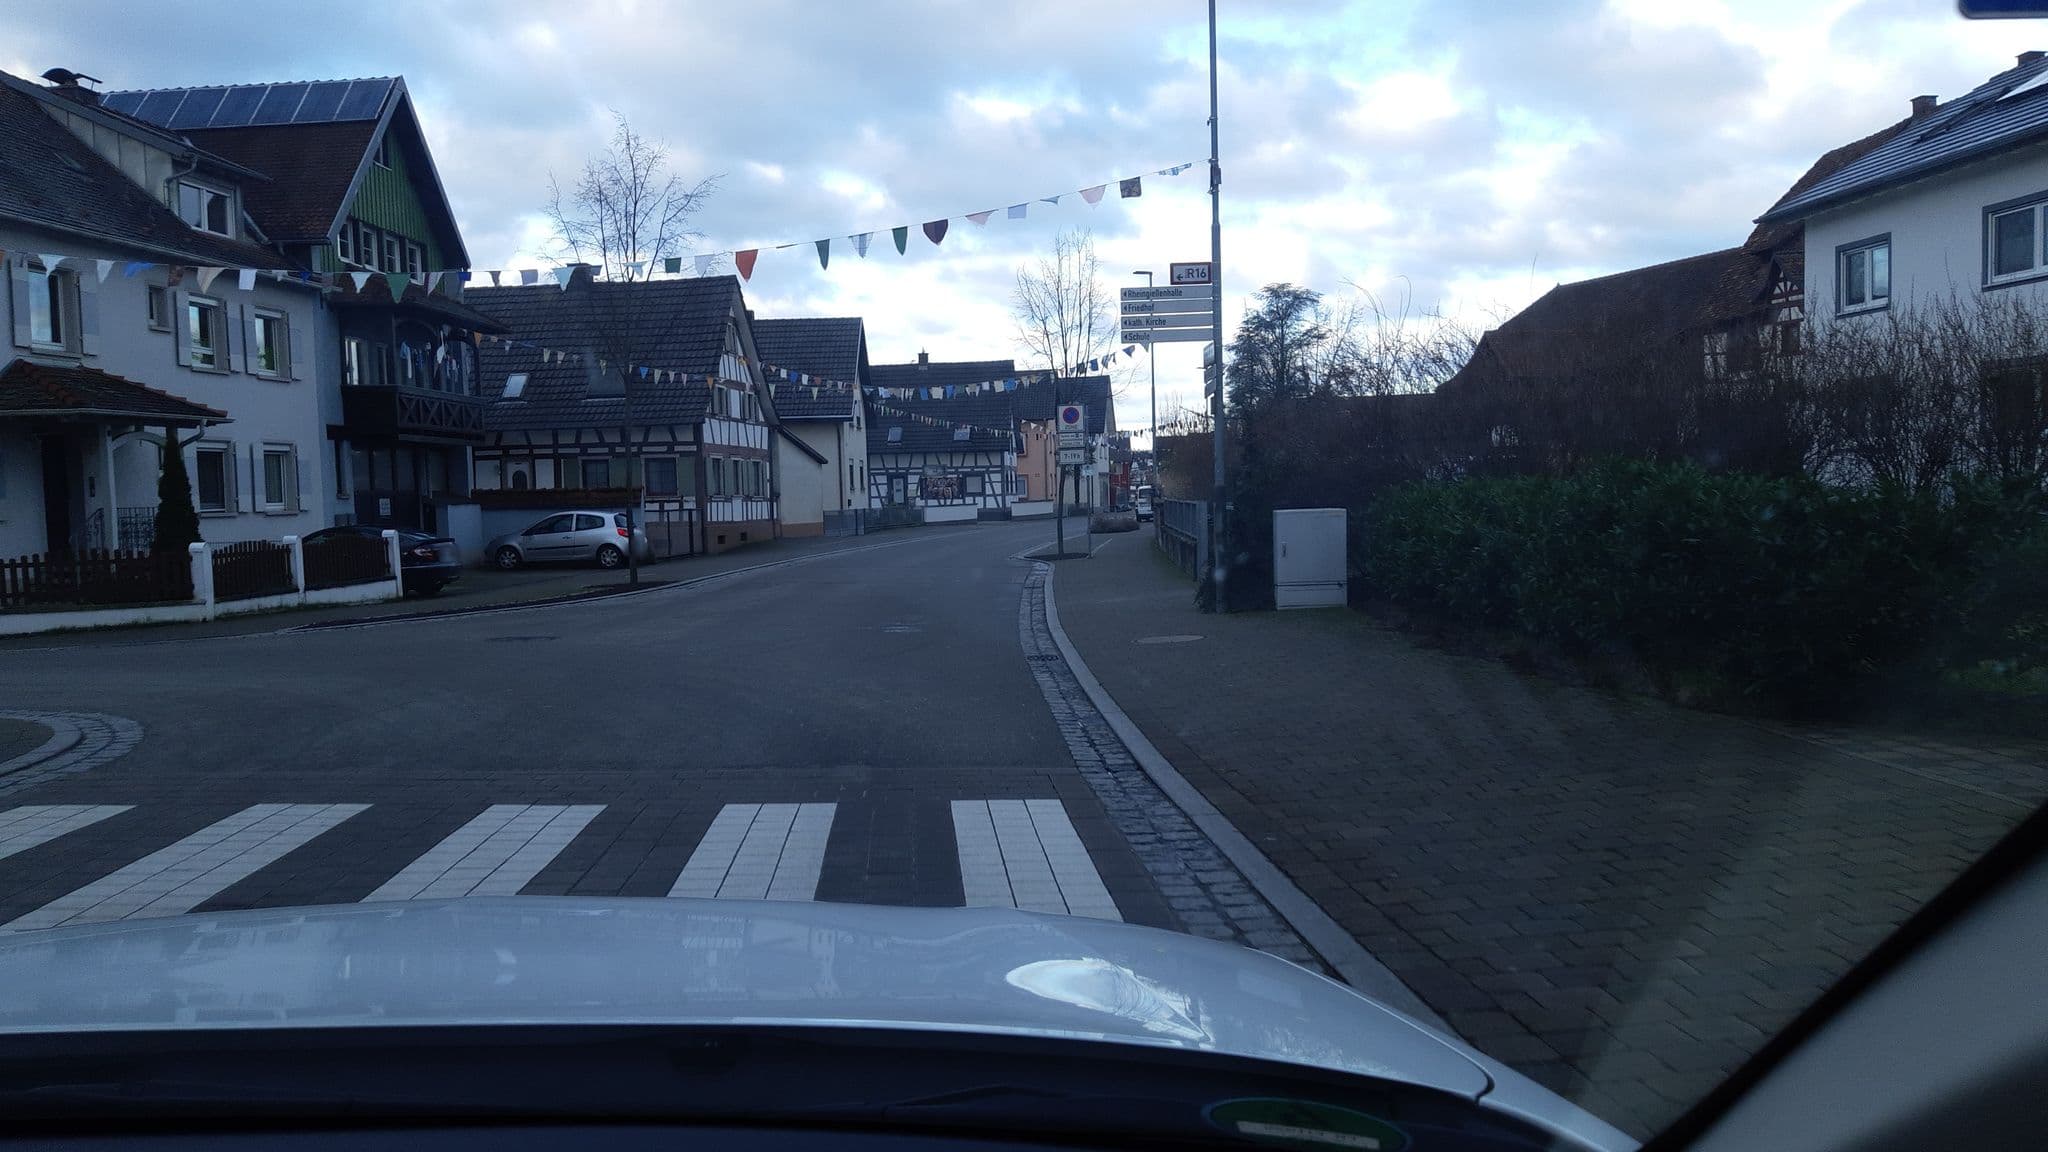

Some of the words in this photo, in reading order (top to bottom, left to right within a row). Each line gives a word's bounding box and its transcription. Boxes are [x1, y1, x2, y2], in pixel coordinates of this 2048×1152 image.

[1187, 268, 1207, 279] R16
[1128, 303, 1155, 313] Friedhof
[1145, 317, 1167, 327] Kirche
[1128, 332, 1150, 341] Schule
